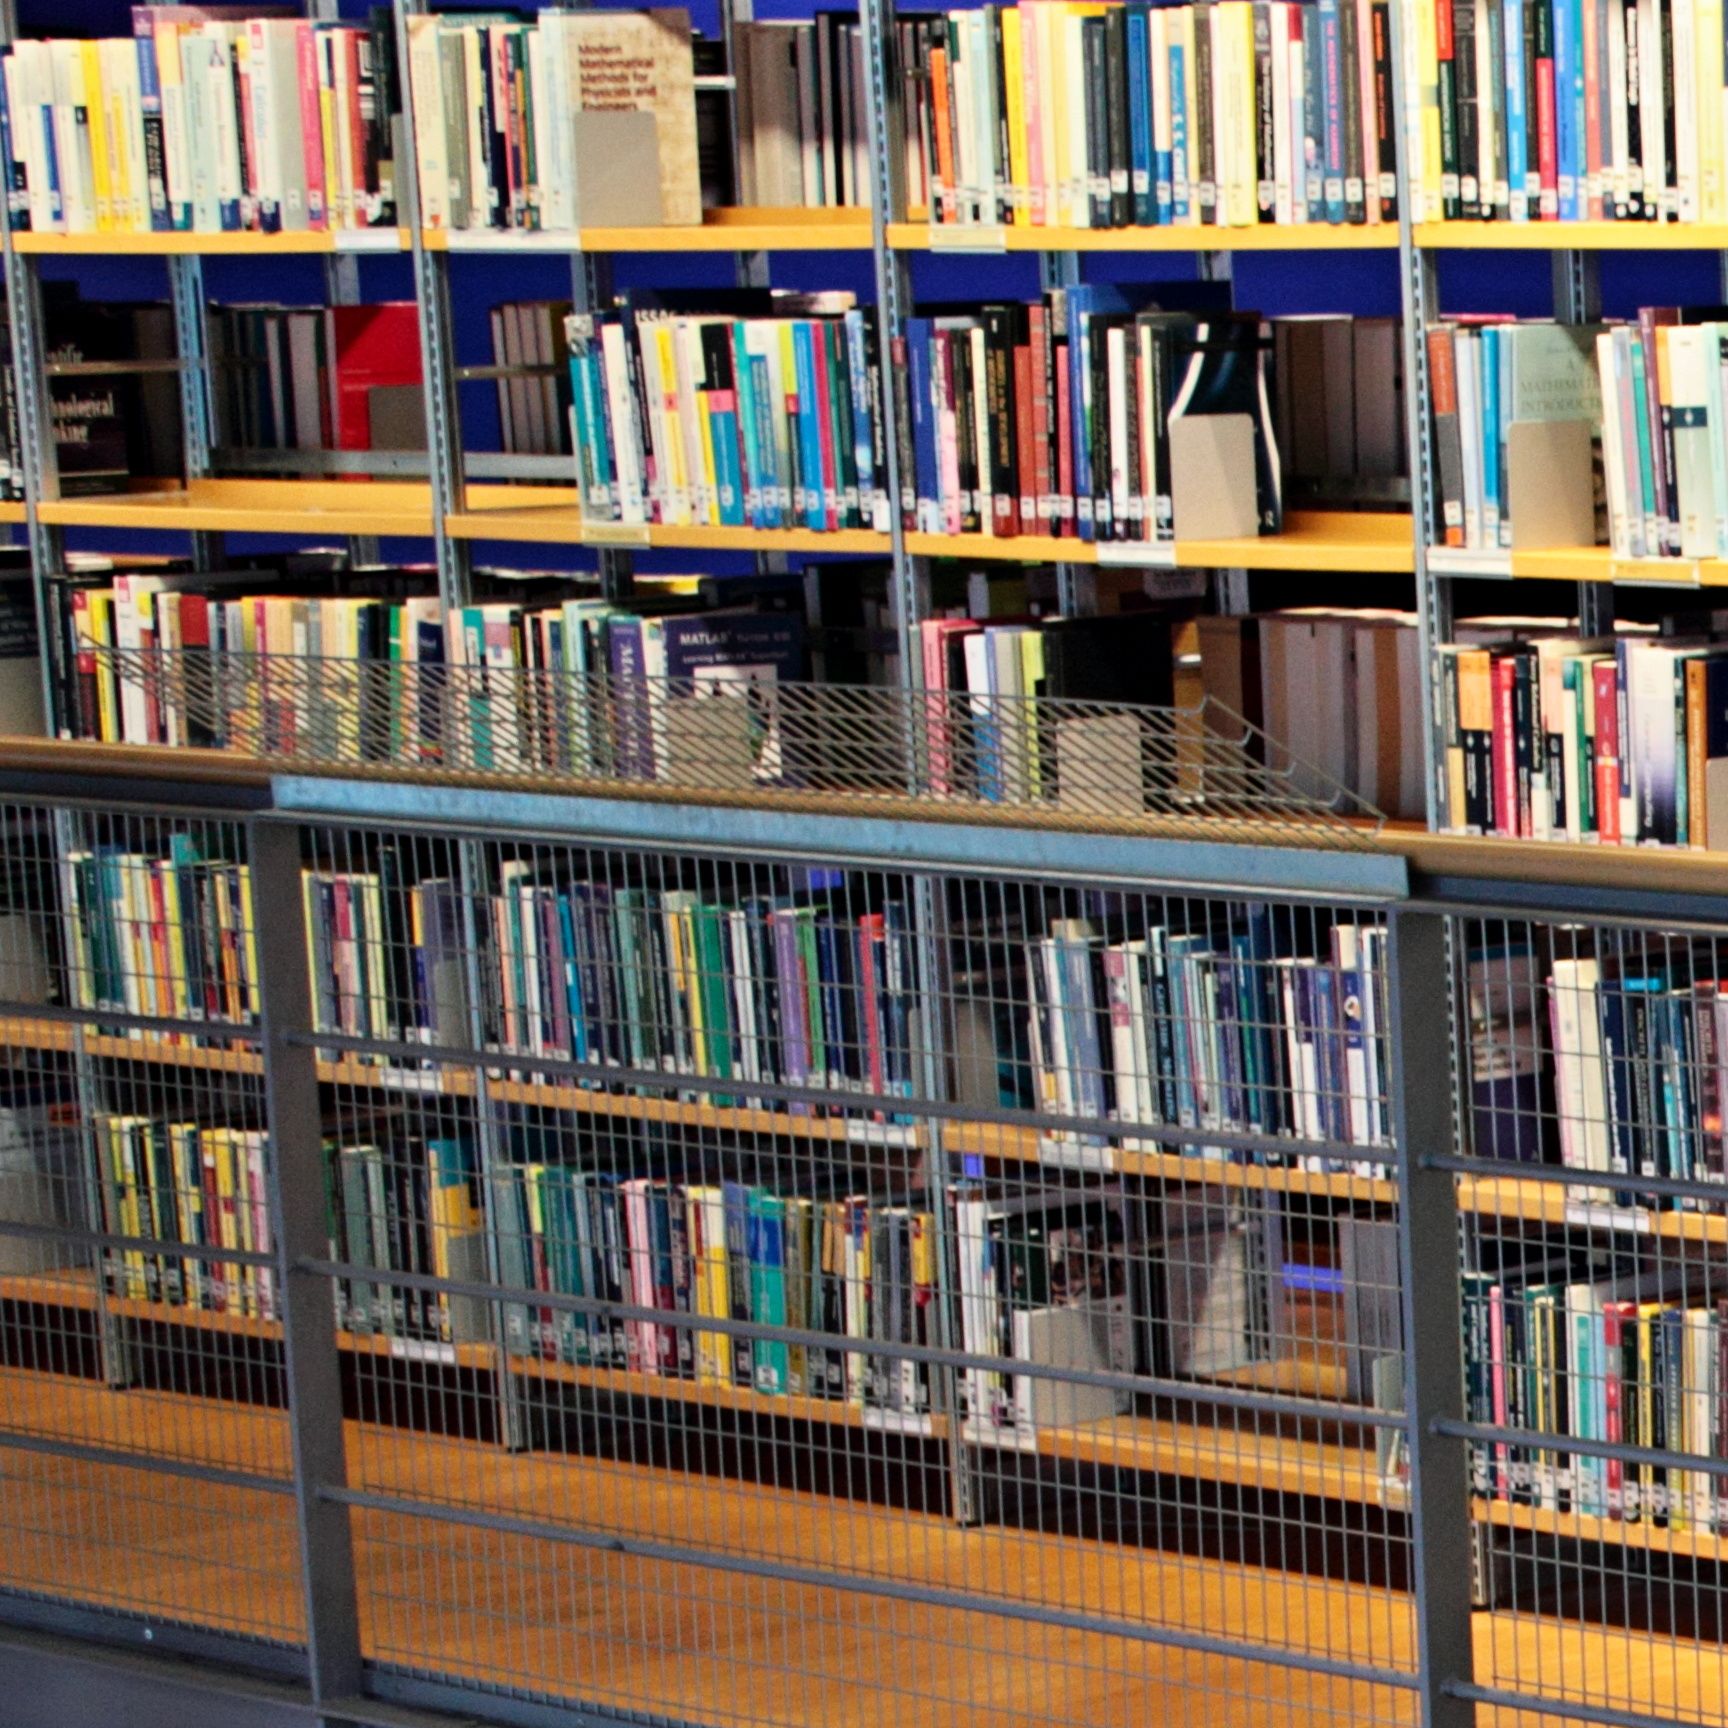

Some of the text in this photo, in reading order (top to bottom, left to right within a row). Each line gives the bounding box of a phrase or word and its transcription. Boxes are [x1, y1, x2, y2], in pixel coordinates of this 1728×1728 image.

[578, 44, 622, 57] Modern
[580, 58, 656, 69] Mathematical
[680, 632, 725, 647] MATLAB
